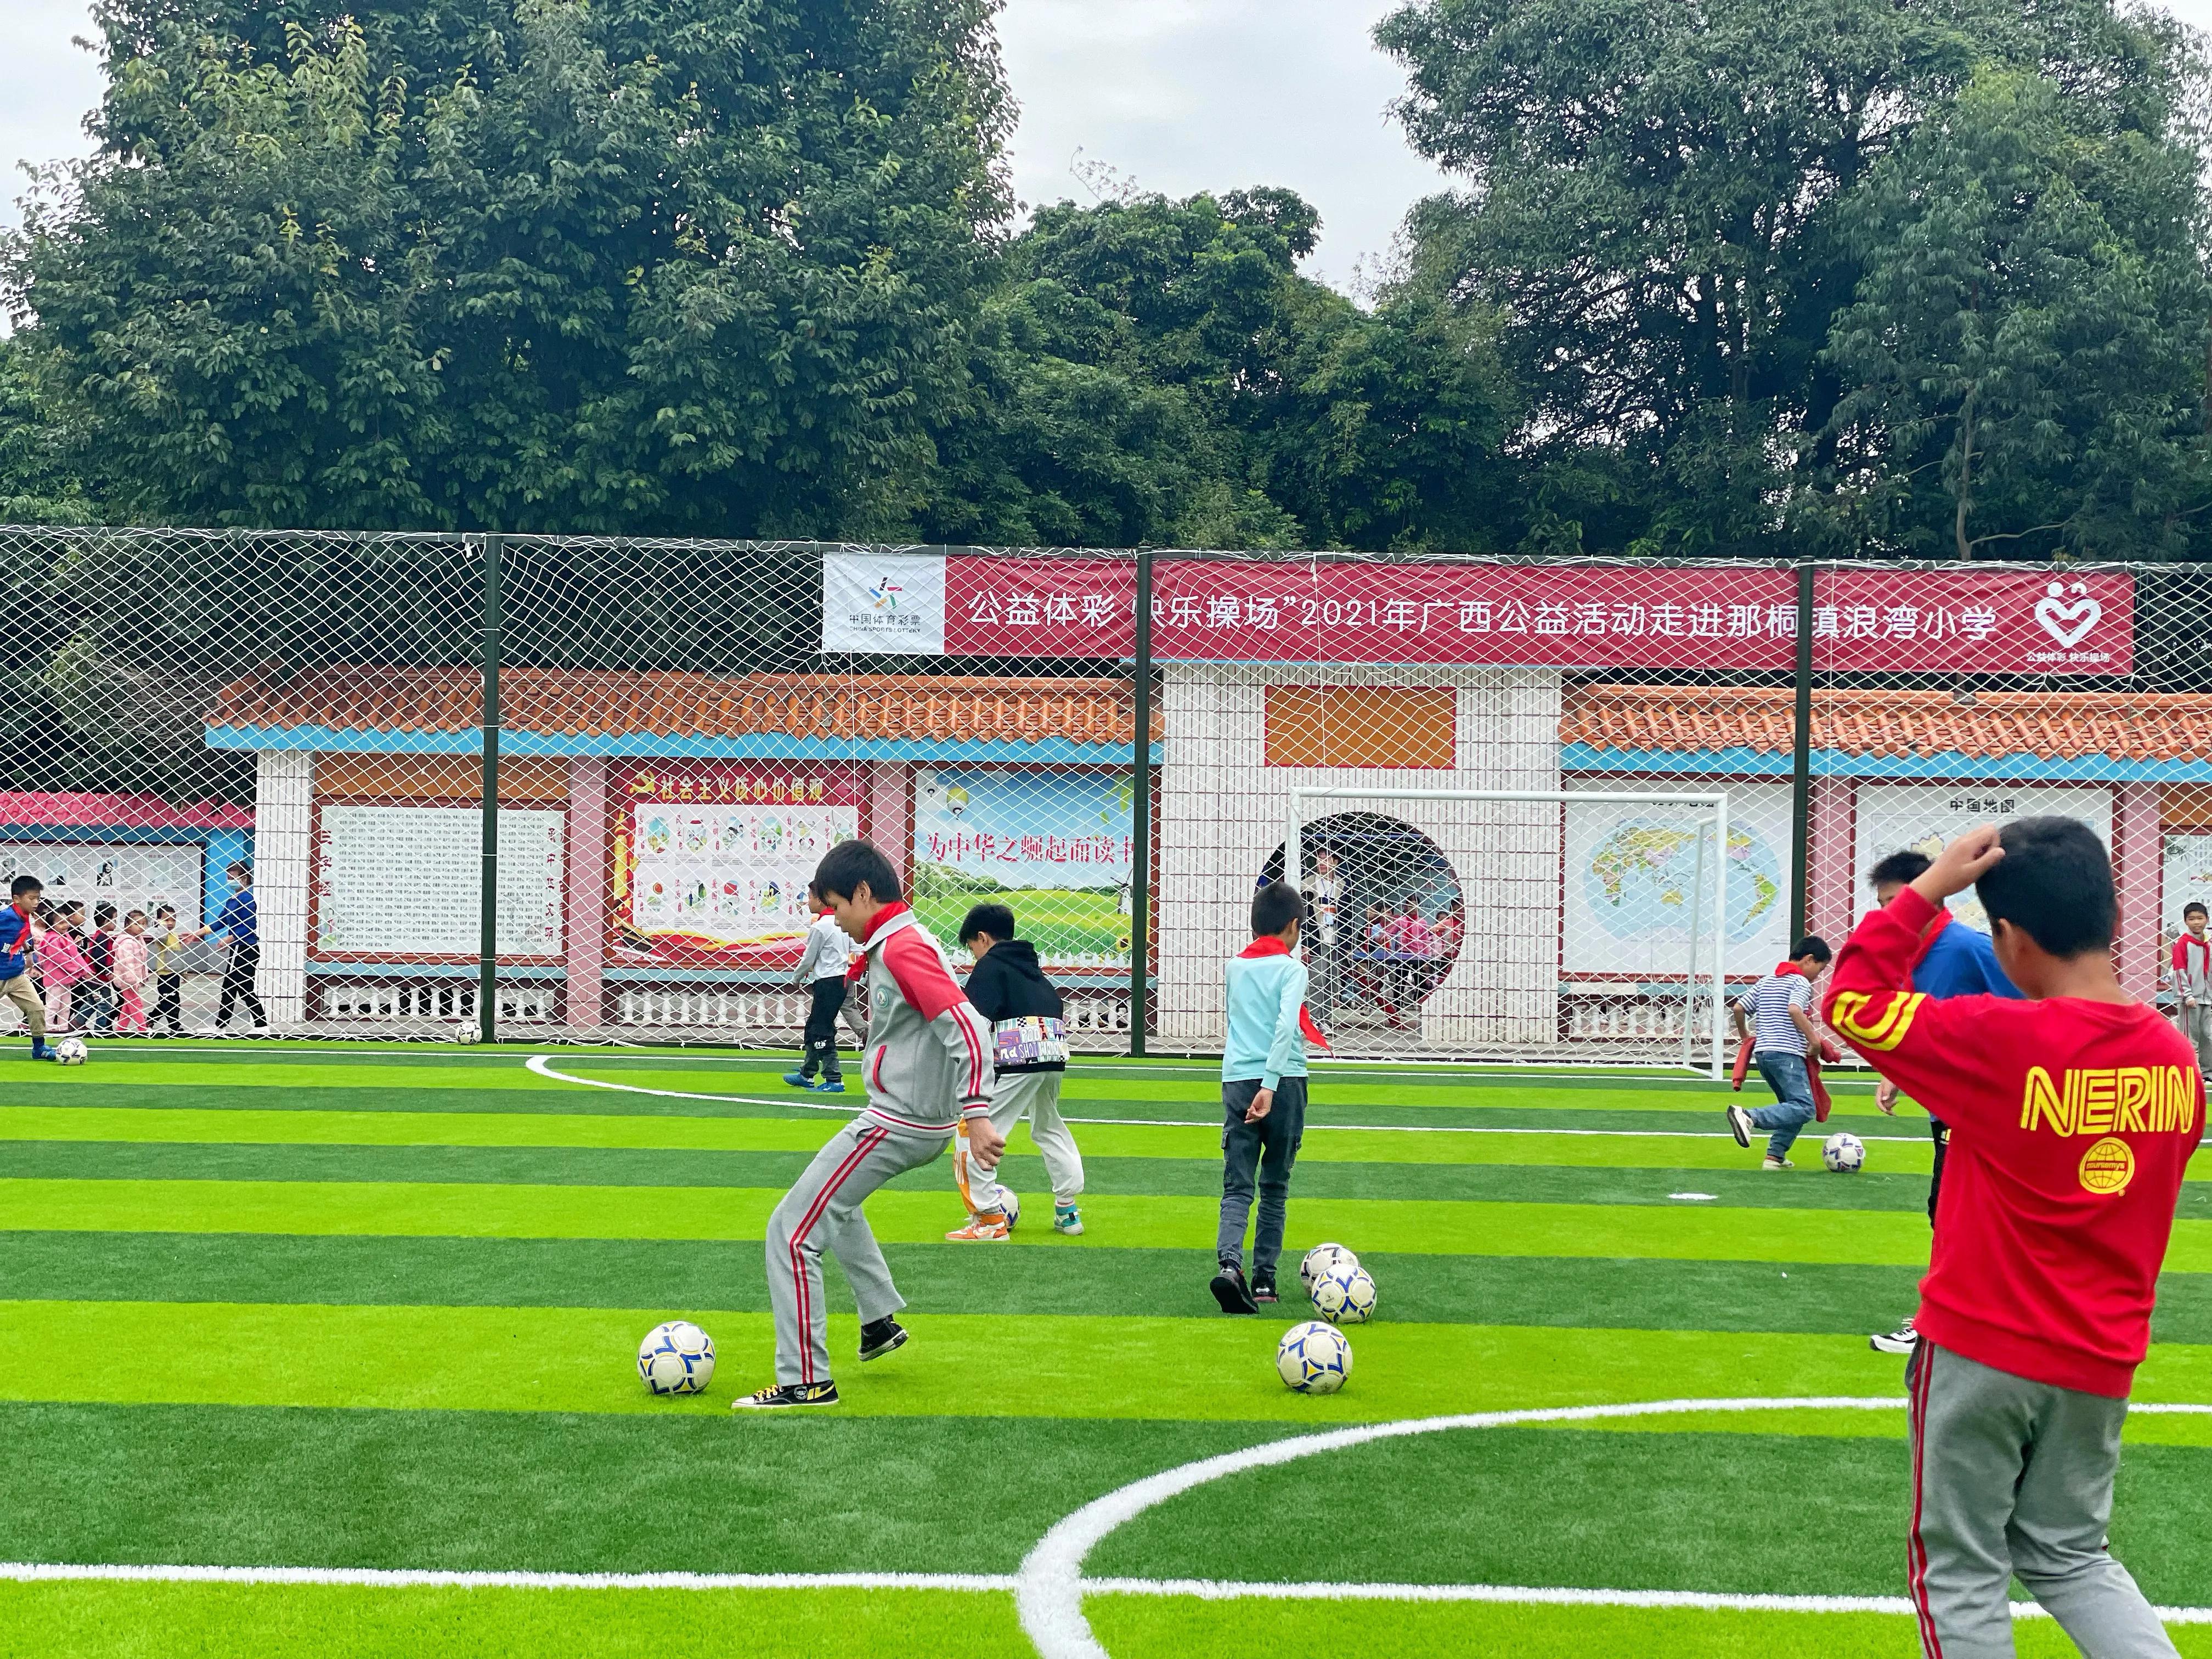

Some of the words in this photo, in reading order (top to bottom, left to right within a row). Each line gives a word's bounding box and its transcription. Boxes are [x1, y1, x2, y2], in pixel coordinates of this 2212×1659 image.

[849, 613, 920, 625] 中国体育彩票
[660, 775, 825, 802] 社会主义核心价值观
[1949, 797, 2016, 814] 中国地图
[2021, 1065, 2196, 1138] NERIN
